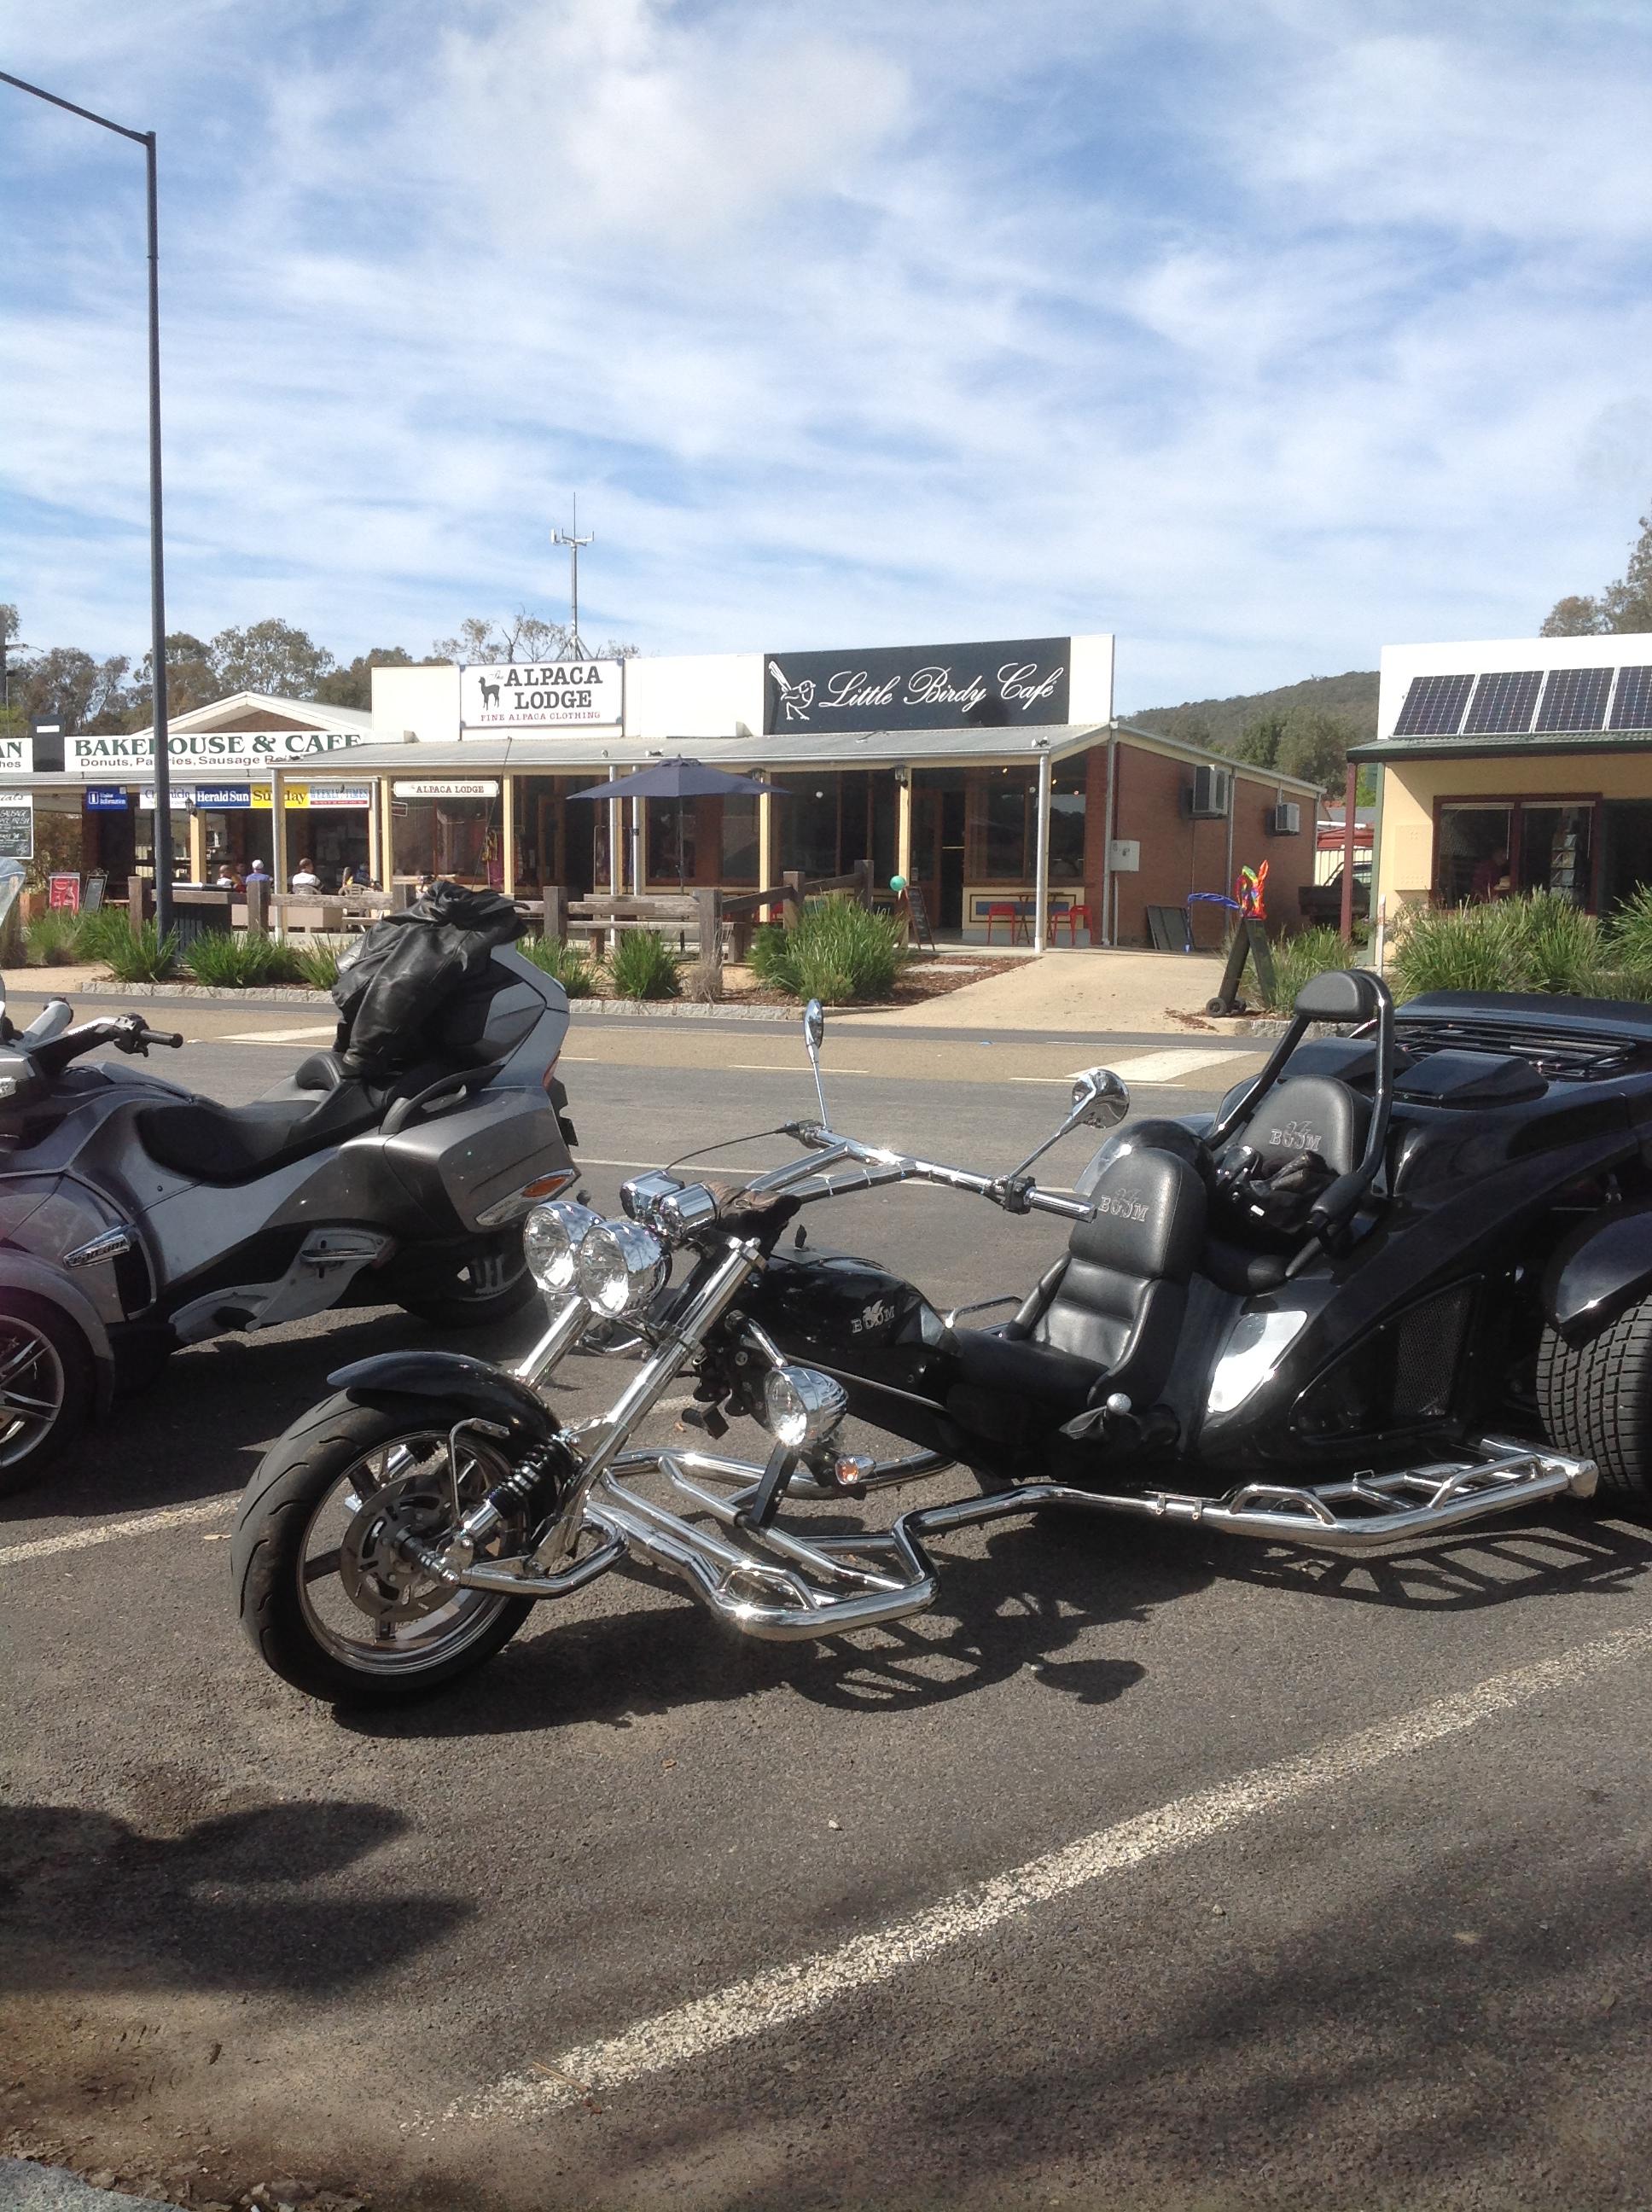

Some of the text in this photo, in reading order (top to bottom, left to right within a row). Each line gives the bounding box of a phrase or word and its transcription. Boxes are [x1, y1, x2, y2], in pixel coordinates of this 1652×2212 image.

[504, 666, 603, 687] ALPACA
[818, 662, 1064, 713] Little Birdy Café
[515, 690, 592, 709] LODGE
[480, 712, 601, 722] FINE ALPACA CLOTHING
[75, 736, 246, 756] BAKEOUSE
[252, 735, 276, 754] &
[80, 758, 133, 766] Donuts,
[199, 755, 260, 765] Sausage
[197, 790, 249, 802] Herald Sun
[253, 789, 307, 805] Suday
[416, 785, 452, 794] ALPACA
[455, 785, 485, 794] LODGE
[1269, 1128, 1322, 1151] BOOM
[1097, 1196, 1149, 1222] BOOM
[851, 1306, 894, 1333] BOOM
